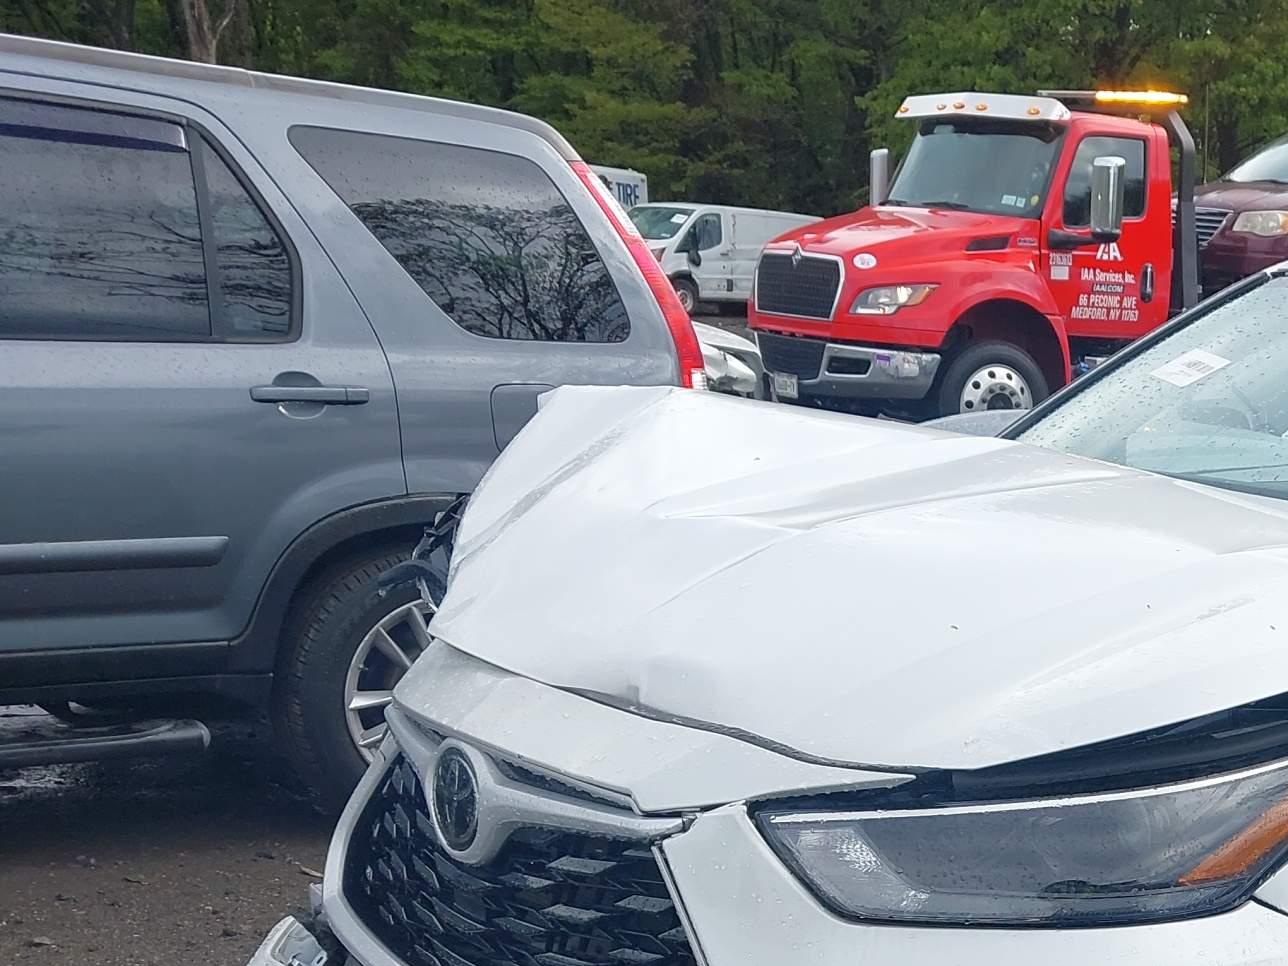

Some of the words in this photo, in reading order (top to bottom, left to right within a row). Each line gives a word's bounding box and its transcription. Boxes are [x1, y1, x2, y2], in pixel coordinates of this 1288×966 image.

[1081, 267, 1094, 281] IAA
[1095, 268, 1124, 283] Services,
[1124, 270, 1136, 284] Inc.
[1079, 293, 1089, 306] 66
[1089, 294, 1121, 308] PECONIC
[1122, 296, 1137, 309] AVE
[1071, 306, 1107, 320] MEDFORD,
[1108, 308, 1121, 320] NY
[1122, 309, 1139, 322] 11763
